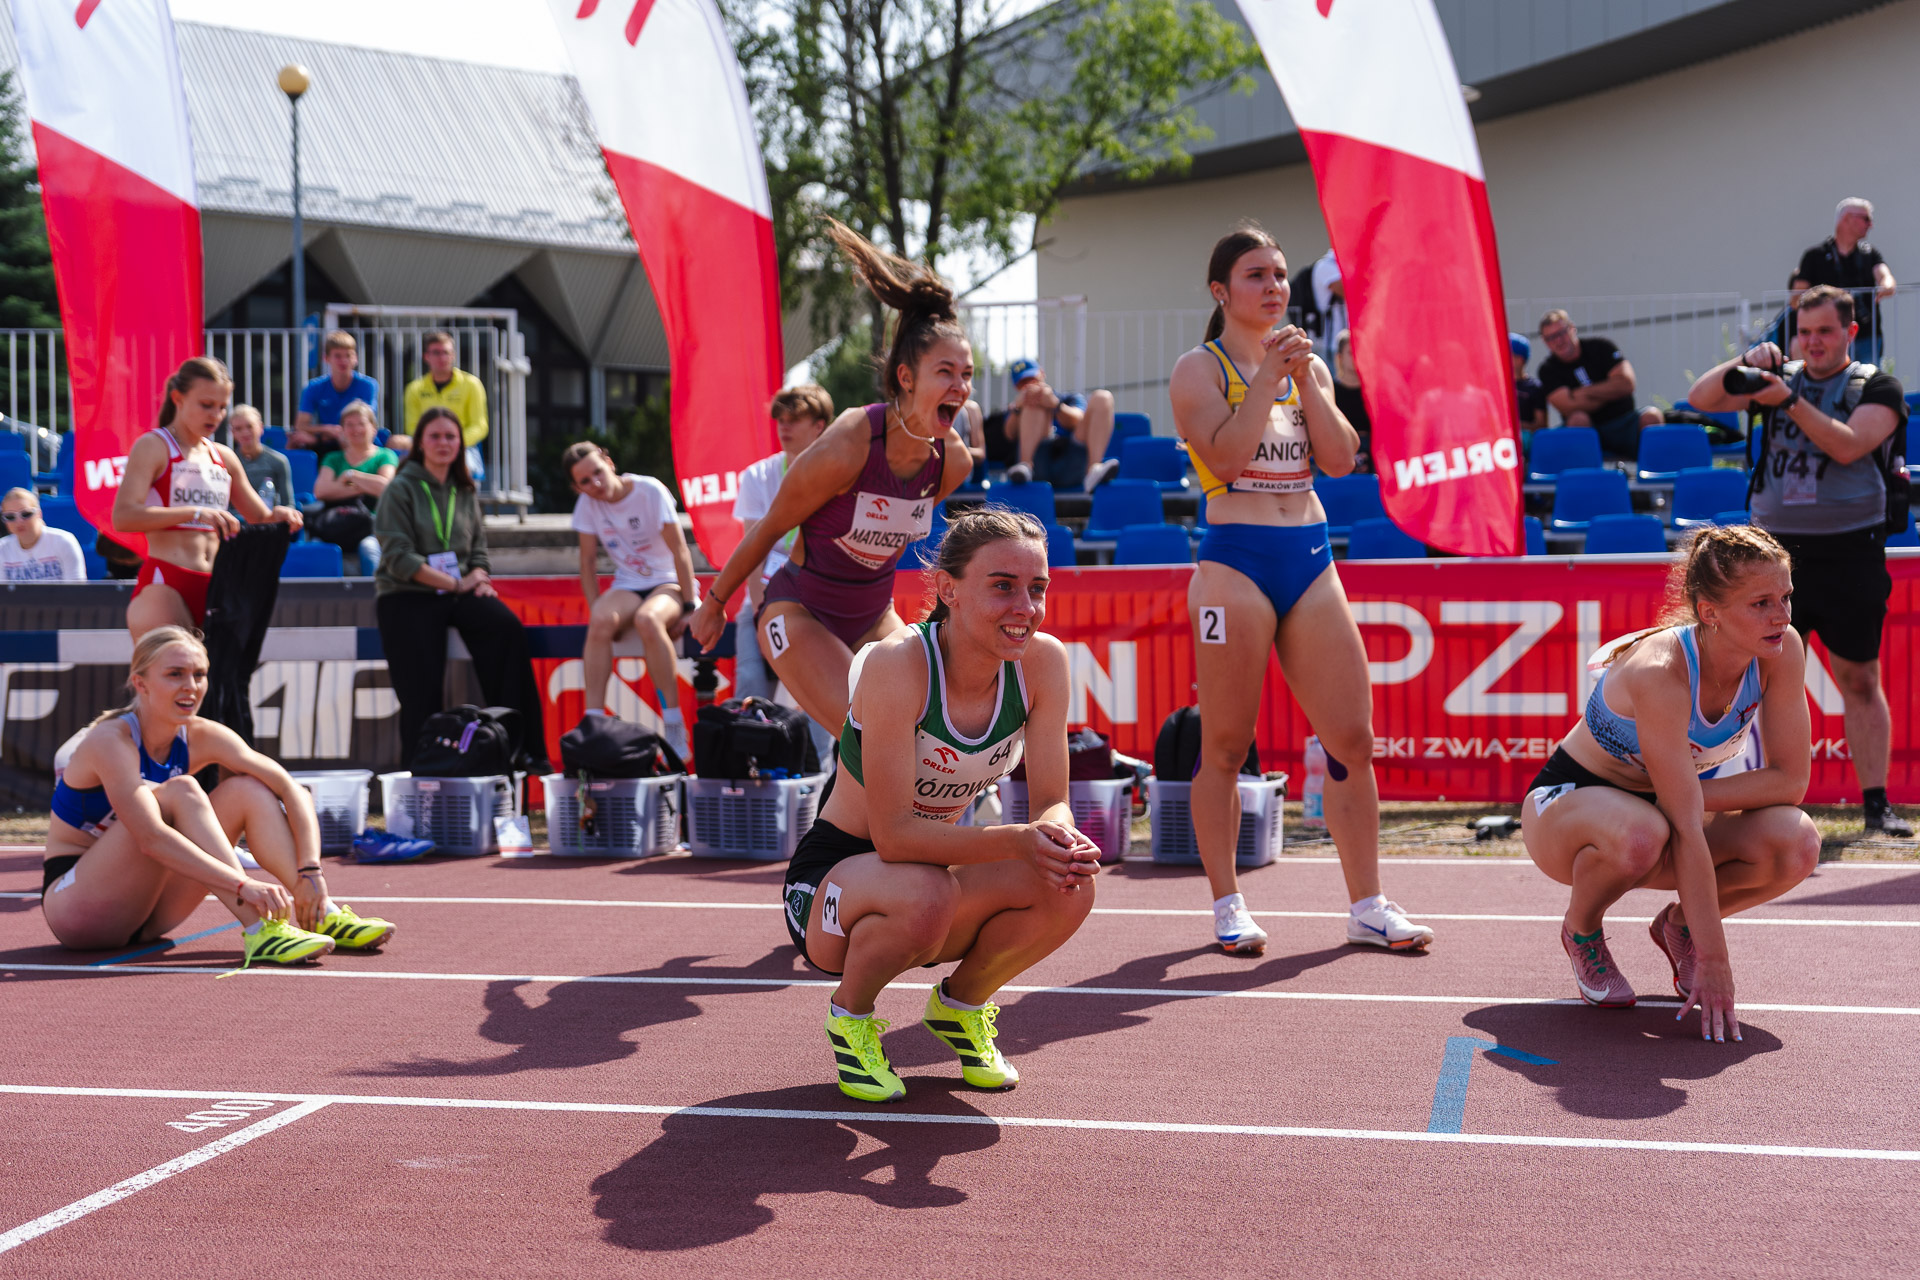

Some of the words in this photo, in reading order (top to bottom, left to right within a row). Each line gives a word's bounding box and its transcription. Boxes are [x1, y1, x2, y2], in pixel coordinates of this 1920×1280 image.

[1770, 408, 1806, 441] FO
[1251, 441, 1313, 461] ANICK
[1772, 449, 1830, 481] 047
[865, 511, 889, 521] ORLEN
[911, 503, 927, 520] 46
[769, 621, 784, 651] 6
[1204, 609, 1220, 641] 2
[1066, 641, 1138, 724] N
[988, 740, 1012, 766] 64
[1371, 736, 1416, 759] SKI
[922, 758, 956, 775] ORLEN
[912, 809, 950, 821] AKÓW
[824, 895, 838, 926] 3
[164, 1100, 276, 1133] 400
